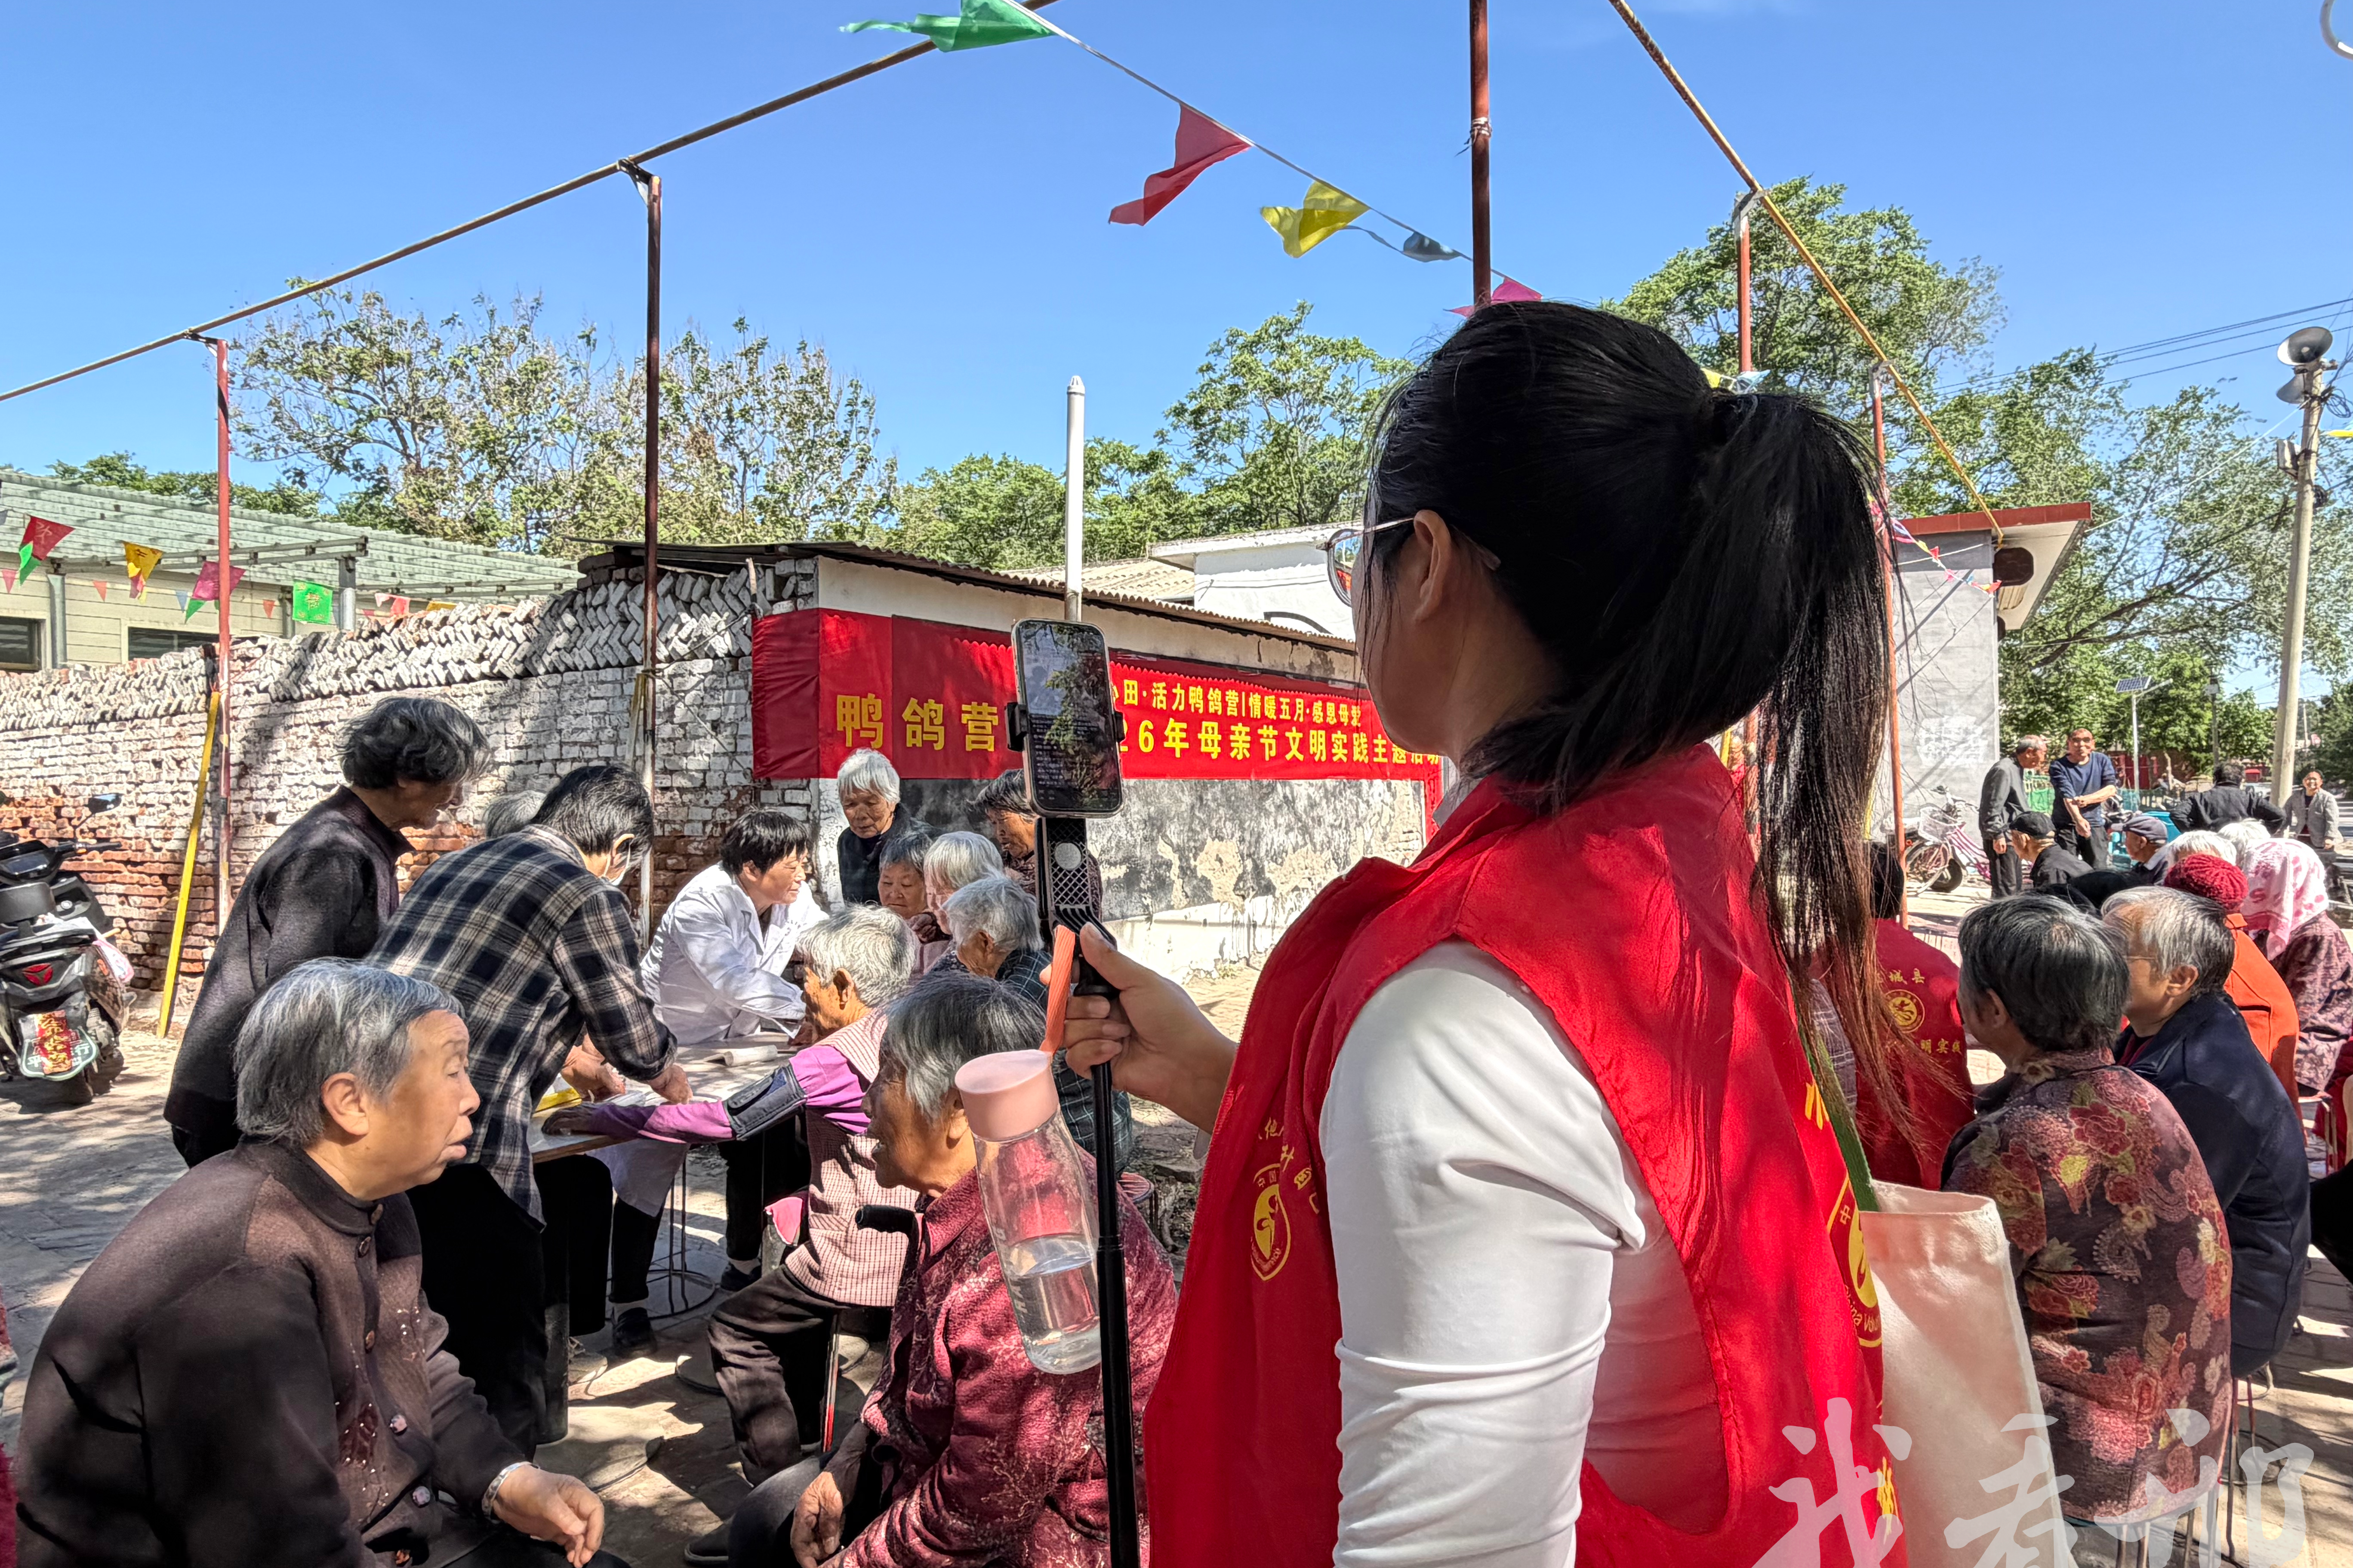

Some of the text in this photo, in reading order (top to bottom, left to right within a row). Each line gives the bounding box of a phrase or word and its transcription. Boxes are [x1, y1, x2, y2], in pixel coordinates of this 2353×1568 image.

[836, 693, 998, 752] 鸭鸽营
[1112, 679, 1361, 727] 田·活力鸭鸽营|情暖五月·感恩母爱
[1877, 968, 1925, 985] 城县
